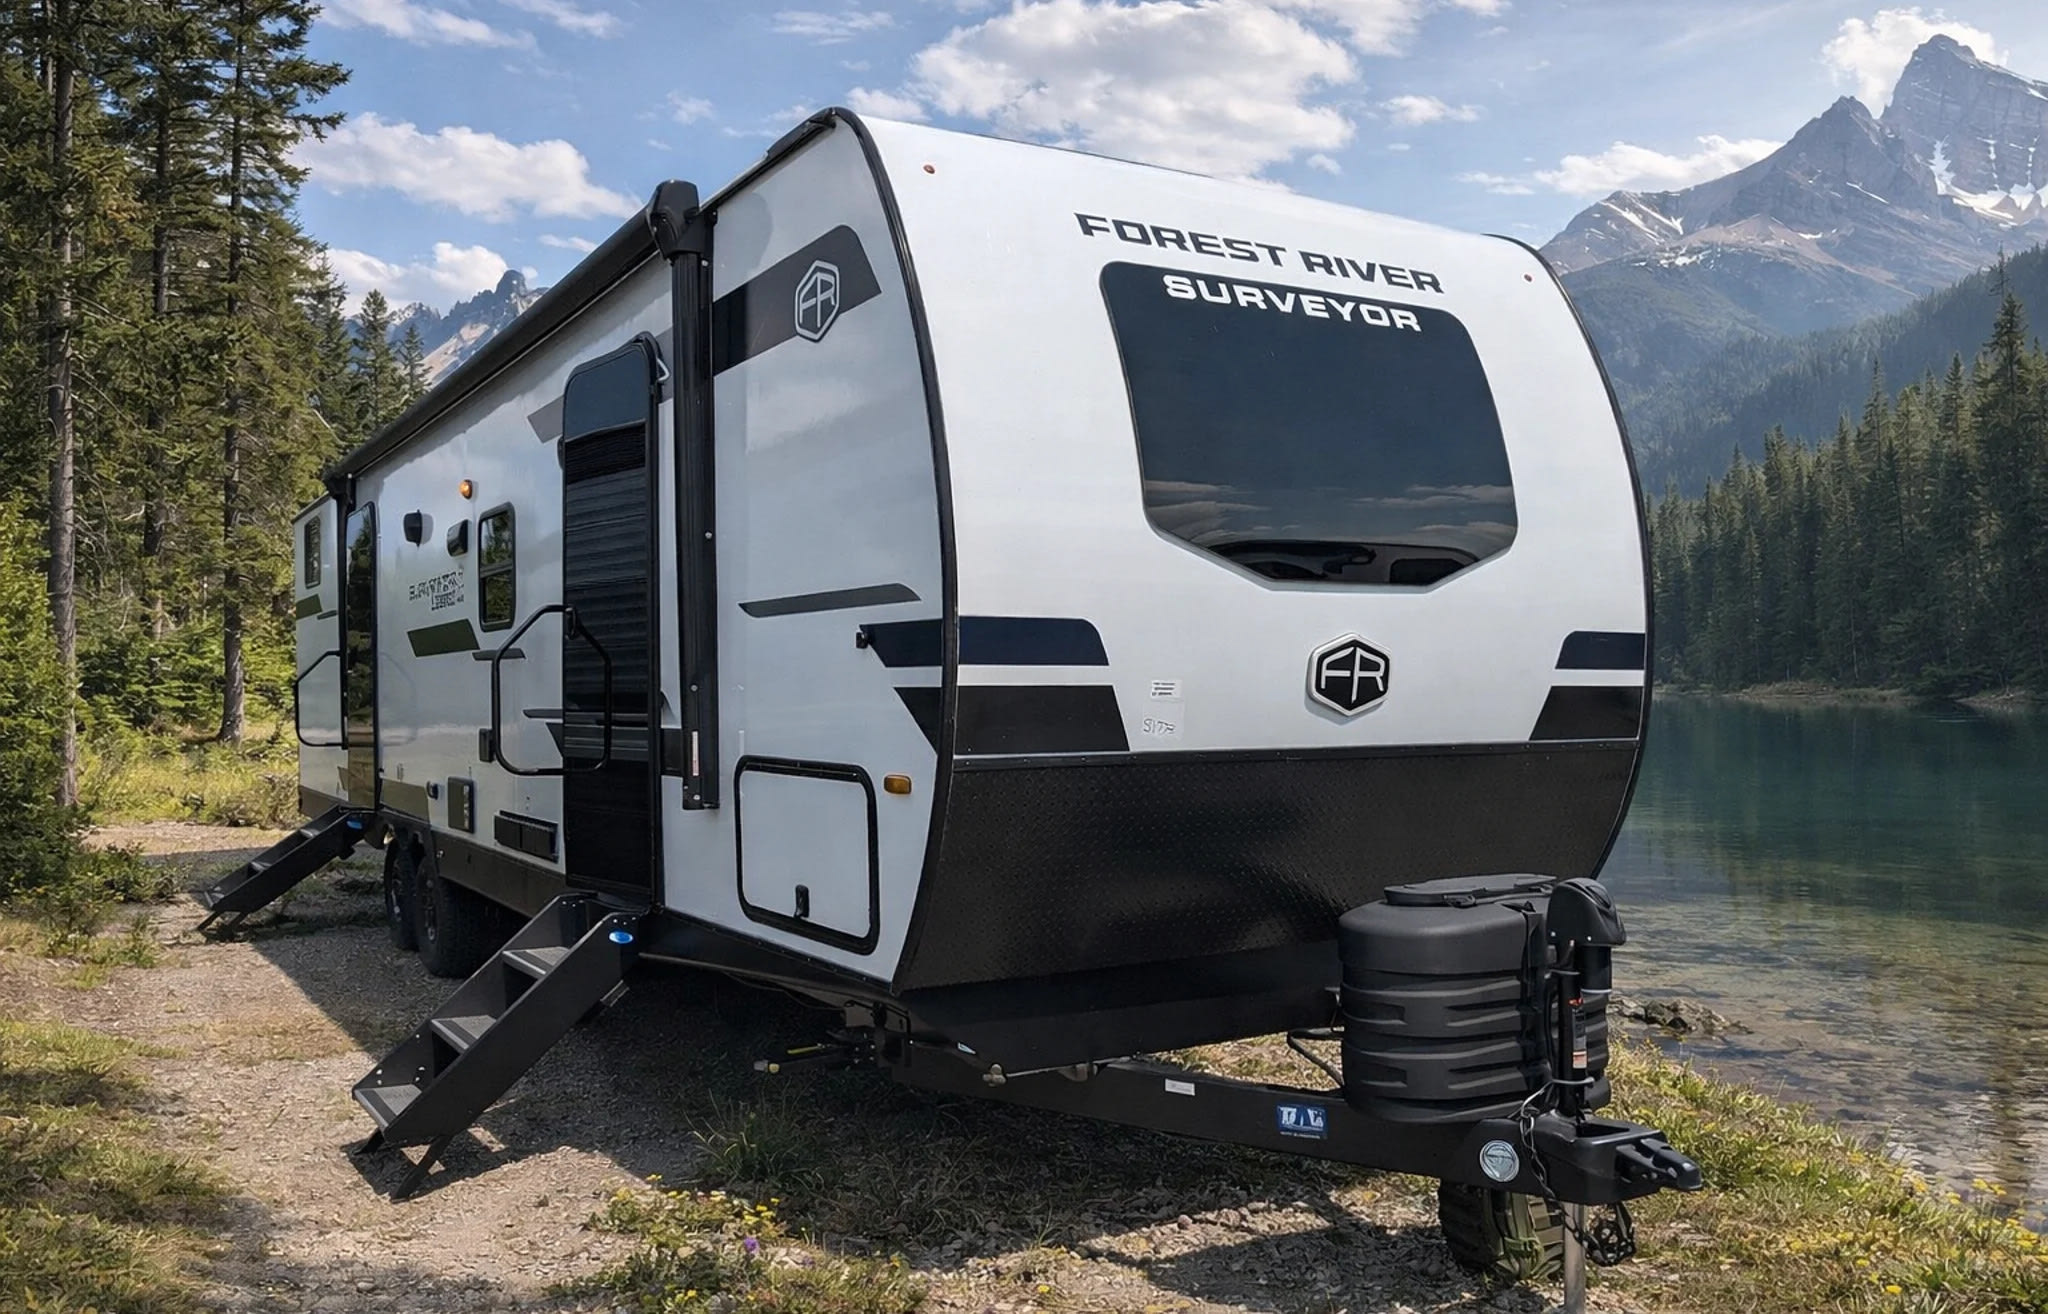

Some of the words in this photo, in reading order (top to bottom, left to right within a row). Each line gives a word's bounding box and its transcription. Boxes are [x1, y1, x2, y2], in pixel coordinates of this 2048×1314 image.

[1073, 213, 1286, 266] FOREST
[1299, 250, 1444, 293] RIVER
[1163, 274, 1422, 332] SURVEYOR
[1320, 646, 1385, 704] FR
